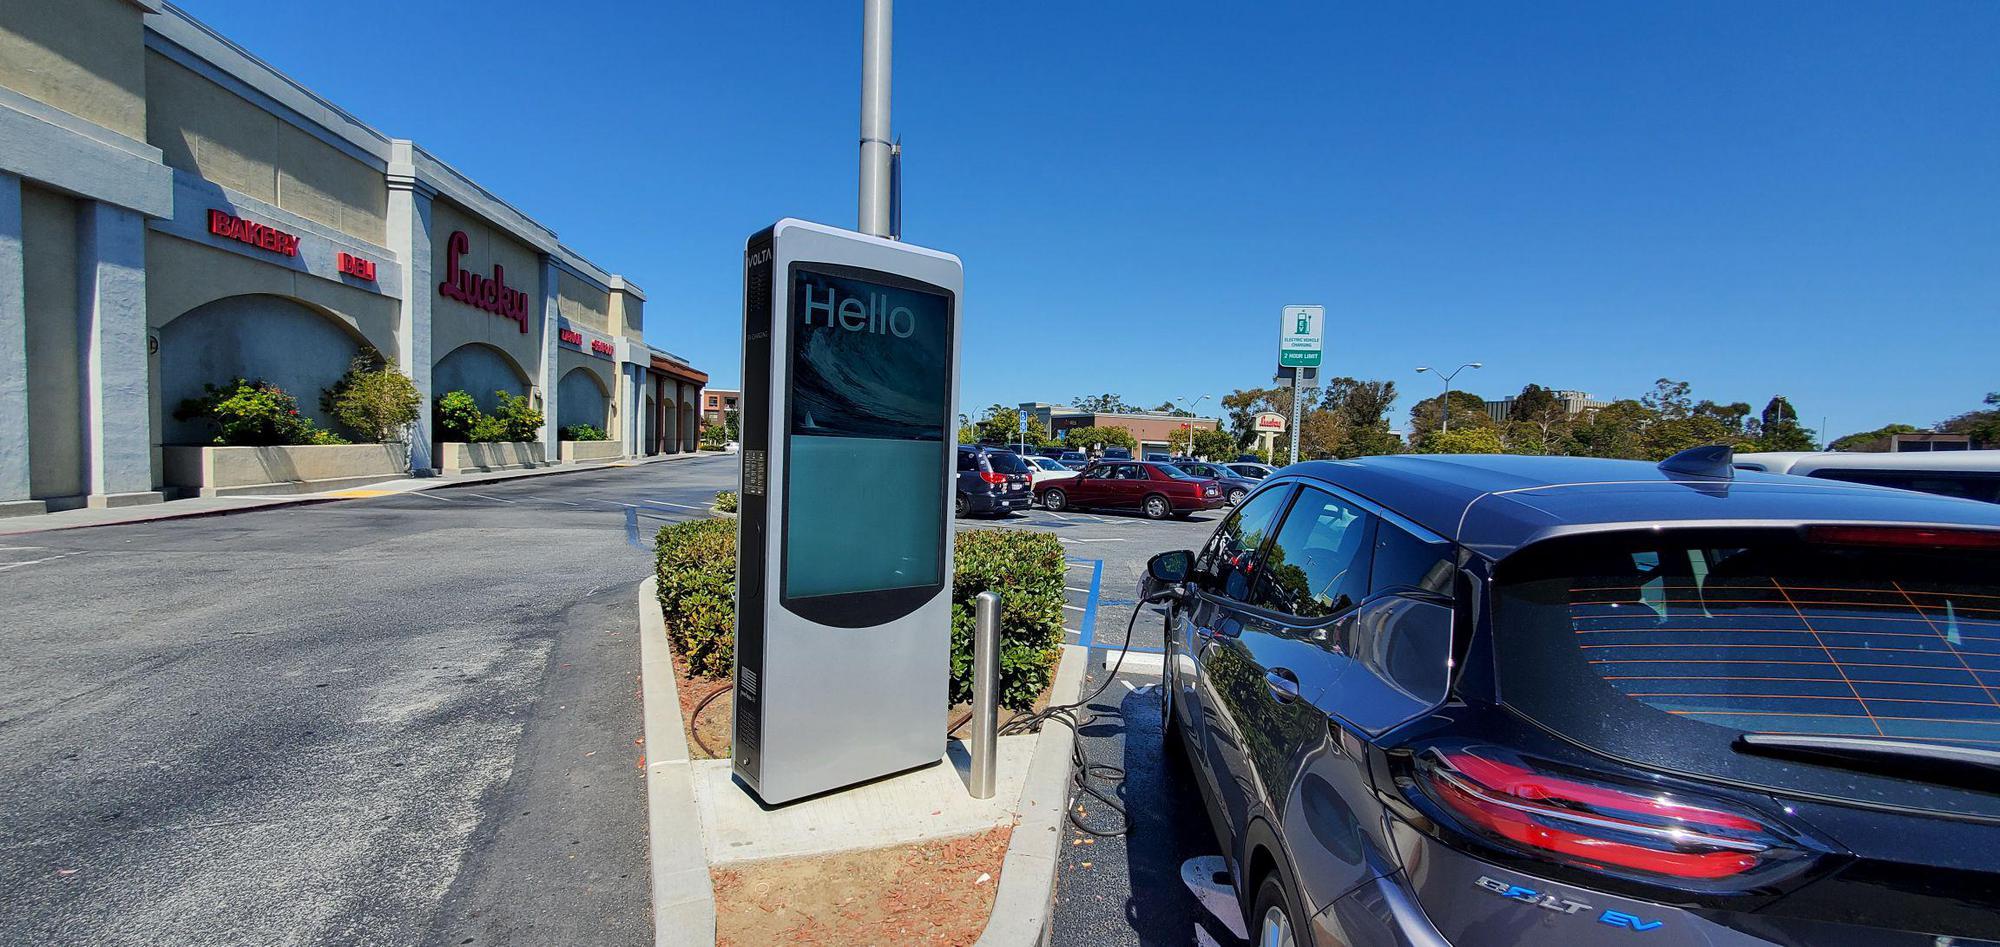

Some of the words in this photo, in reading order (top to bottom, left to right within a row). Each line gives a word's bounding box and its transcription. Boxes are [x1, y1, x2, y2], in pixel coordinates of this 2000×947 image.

[208, 208, 301, 257] BAKERY
[748, 248, 772, 267] VOLTA
[337, 251, 377, 282] DELI
[439, 230, 529, 334] Lucky
[804, 283, 916, 339] Hello
[1473, 875, 1593, 915] BOLT
[1597, 908, 1664, 932] EV
